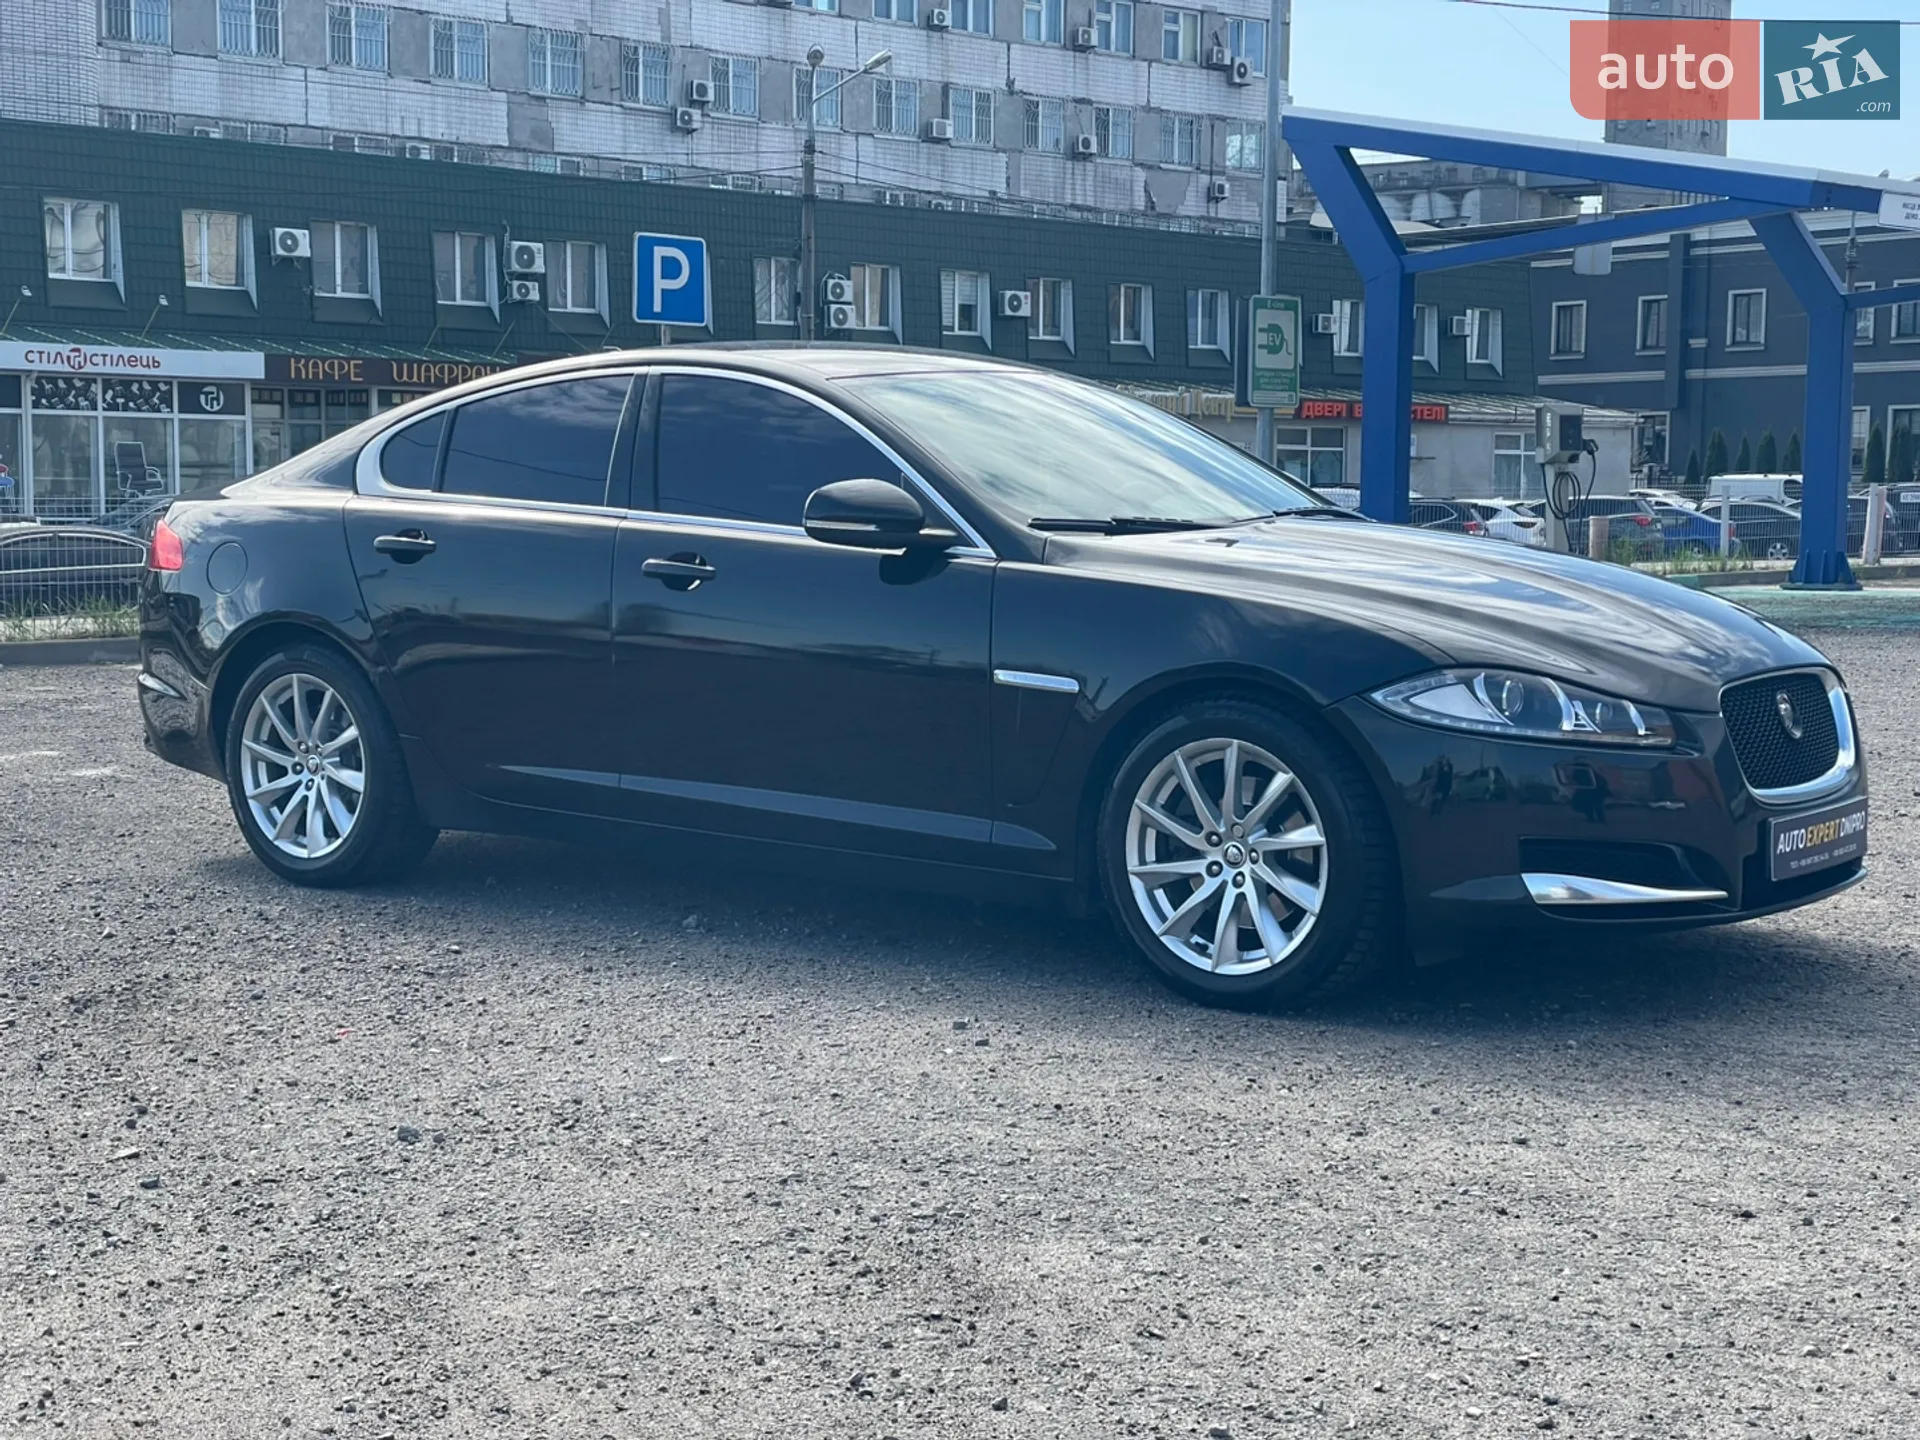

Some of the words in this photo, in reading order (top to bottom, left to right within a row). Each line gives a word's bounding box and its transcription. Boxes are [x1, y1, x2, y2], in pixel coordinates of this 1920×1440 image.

[653, 245, 690, 313] P
[1268, 332, 1282, 346] EV
[290, 357, 364, 382] КАФЕ
[1302, 401, 1347, 419] ДВЕРІ
[1411, 405, 1447, 421] ТЕЛІ
